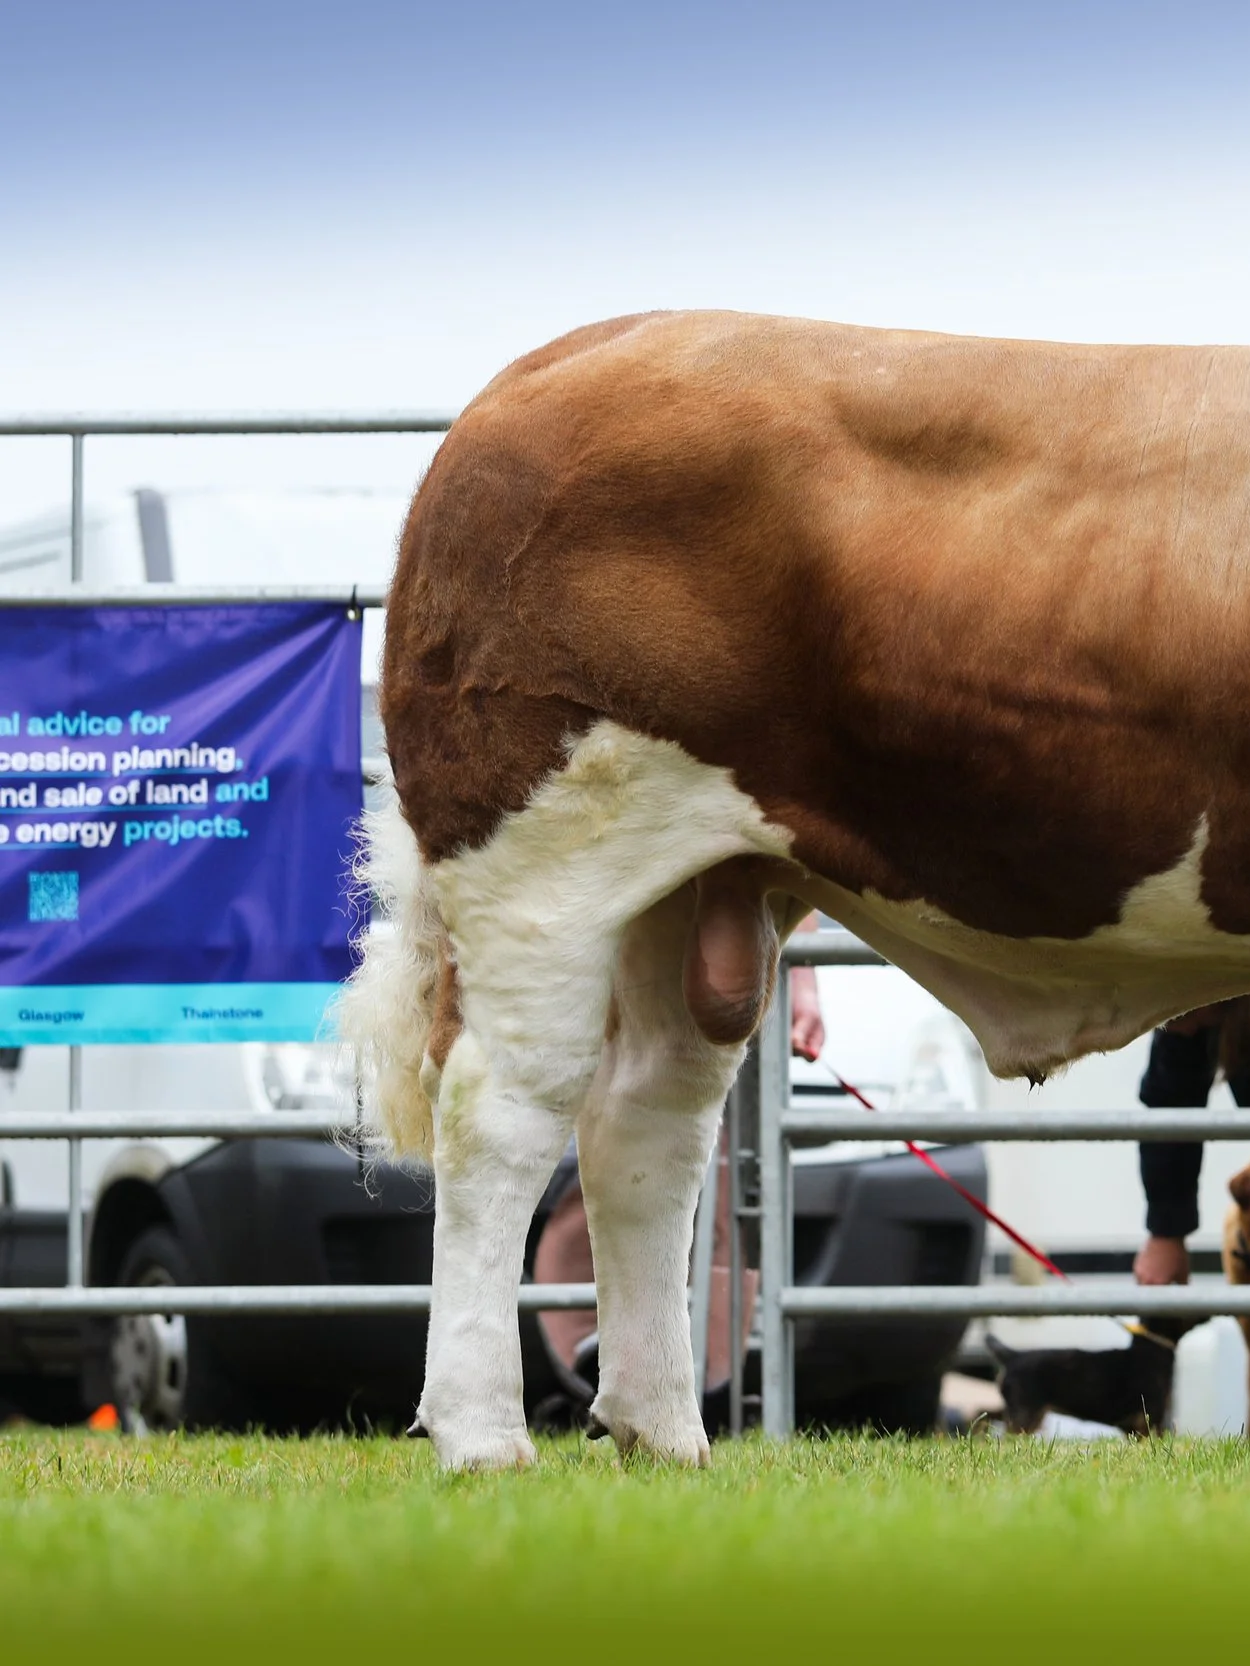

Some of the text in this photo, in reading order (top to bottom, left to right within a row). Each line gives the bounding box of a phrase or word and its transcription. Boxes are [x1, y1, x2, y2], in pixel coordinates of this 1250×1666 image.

[27, 710, 123, 736] advice
[129, 709, 171, 736] for
[0, 741, 244, 778] cession planning.
[43, 782, 103, 808] sale
[108, 779, 140, 806] of
[146, 778, 208, 805] land
[215, 775, 269, 803] and
[15, 821, 118, 849] energy
[123, 814, 249, 847] projects.
[18, 1006, 264, 1024] Glasgow Thainstone
